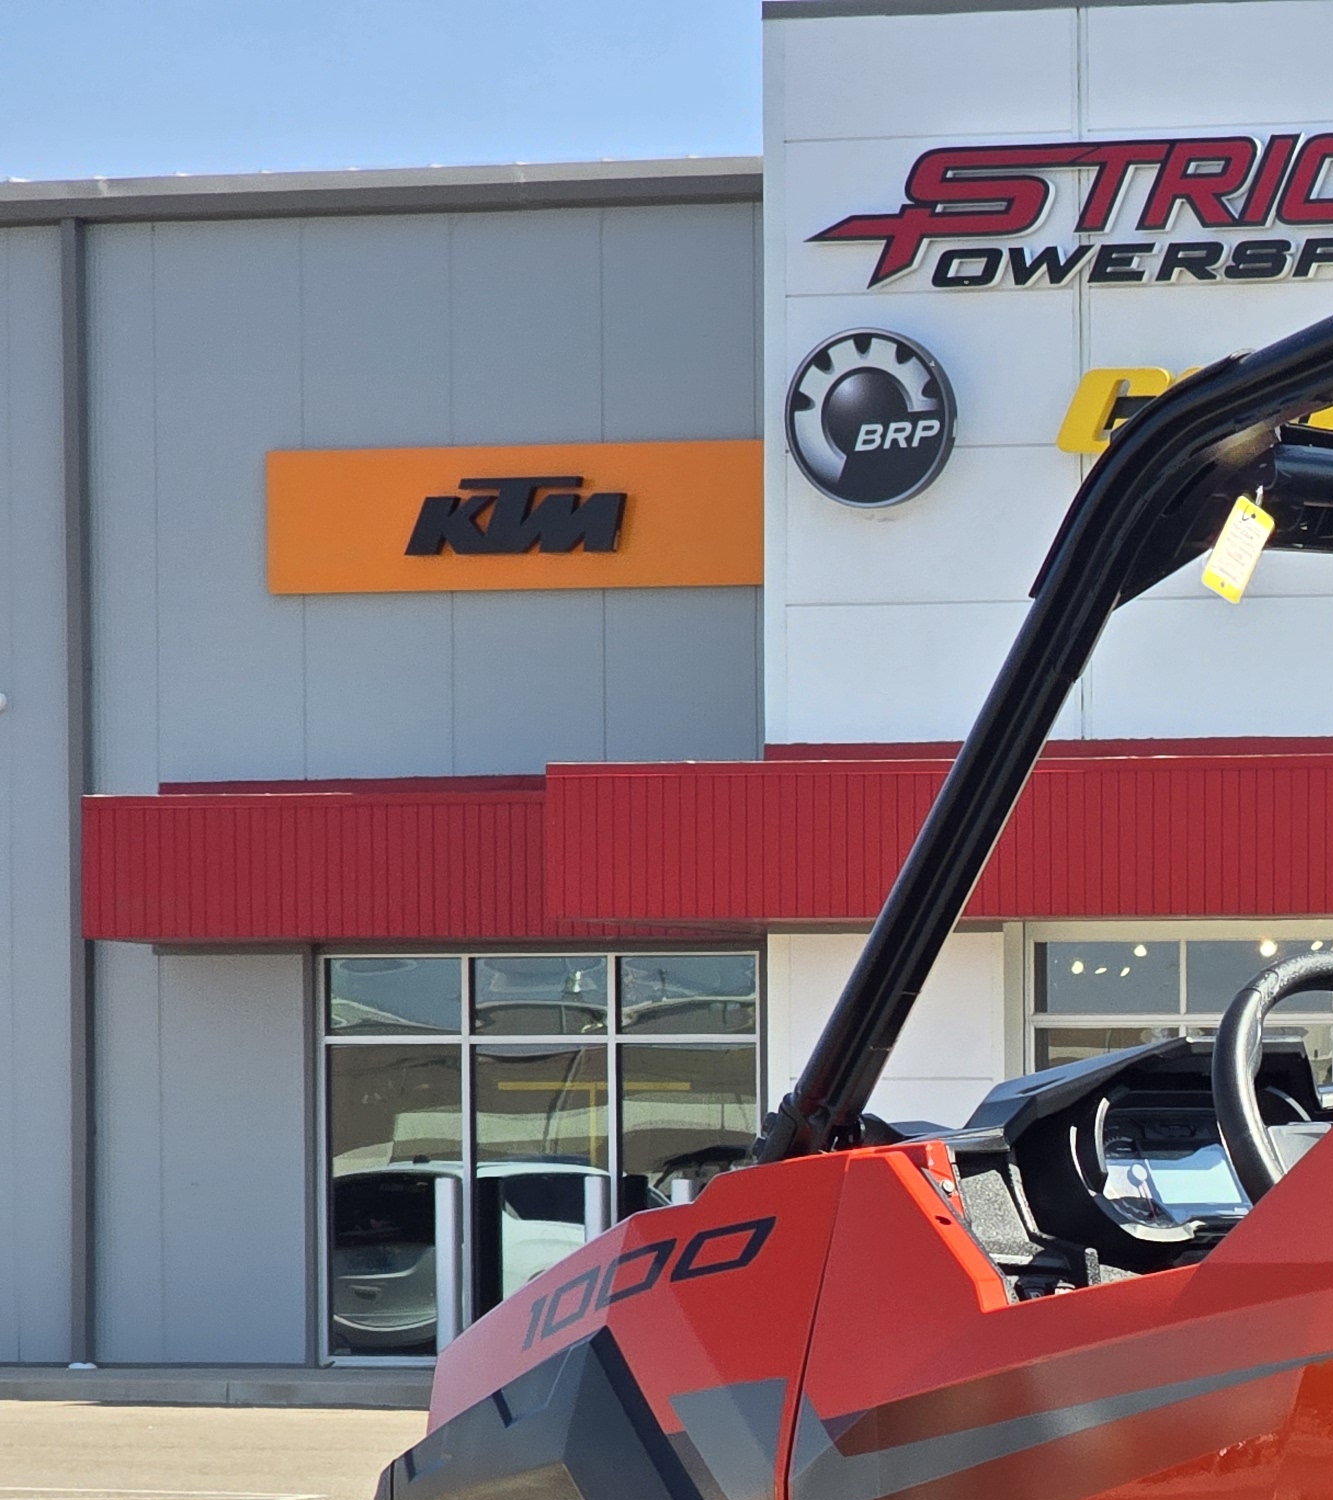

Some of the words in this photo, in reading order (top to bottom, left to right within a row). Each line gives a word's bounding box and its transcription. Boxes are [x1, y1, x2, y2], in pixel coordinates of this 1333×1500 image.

[854, 419, 940, 452] BRP
[404, 475, 627, 556] KTM
[521, 1216, 777, 1351] 1000
